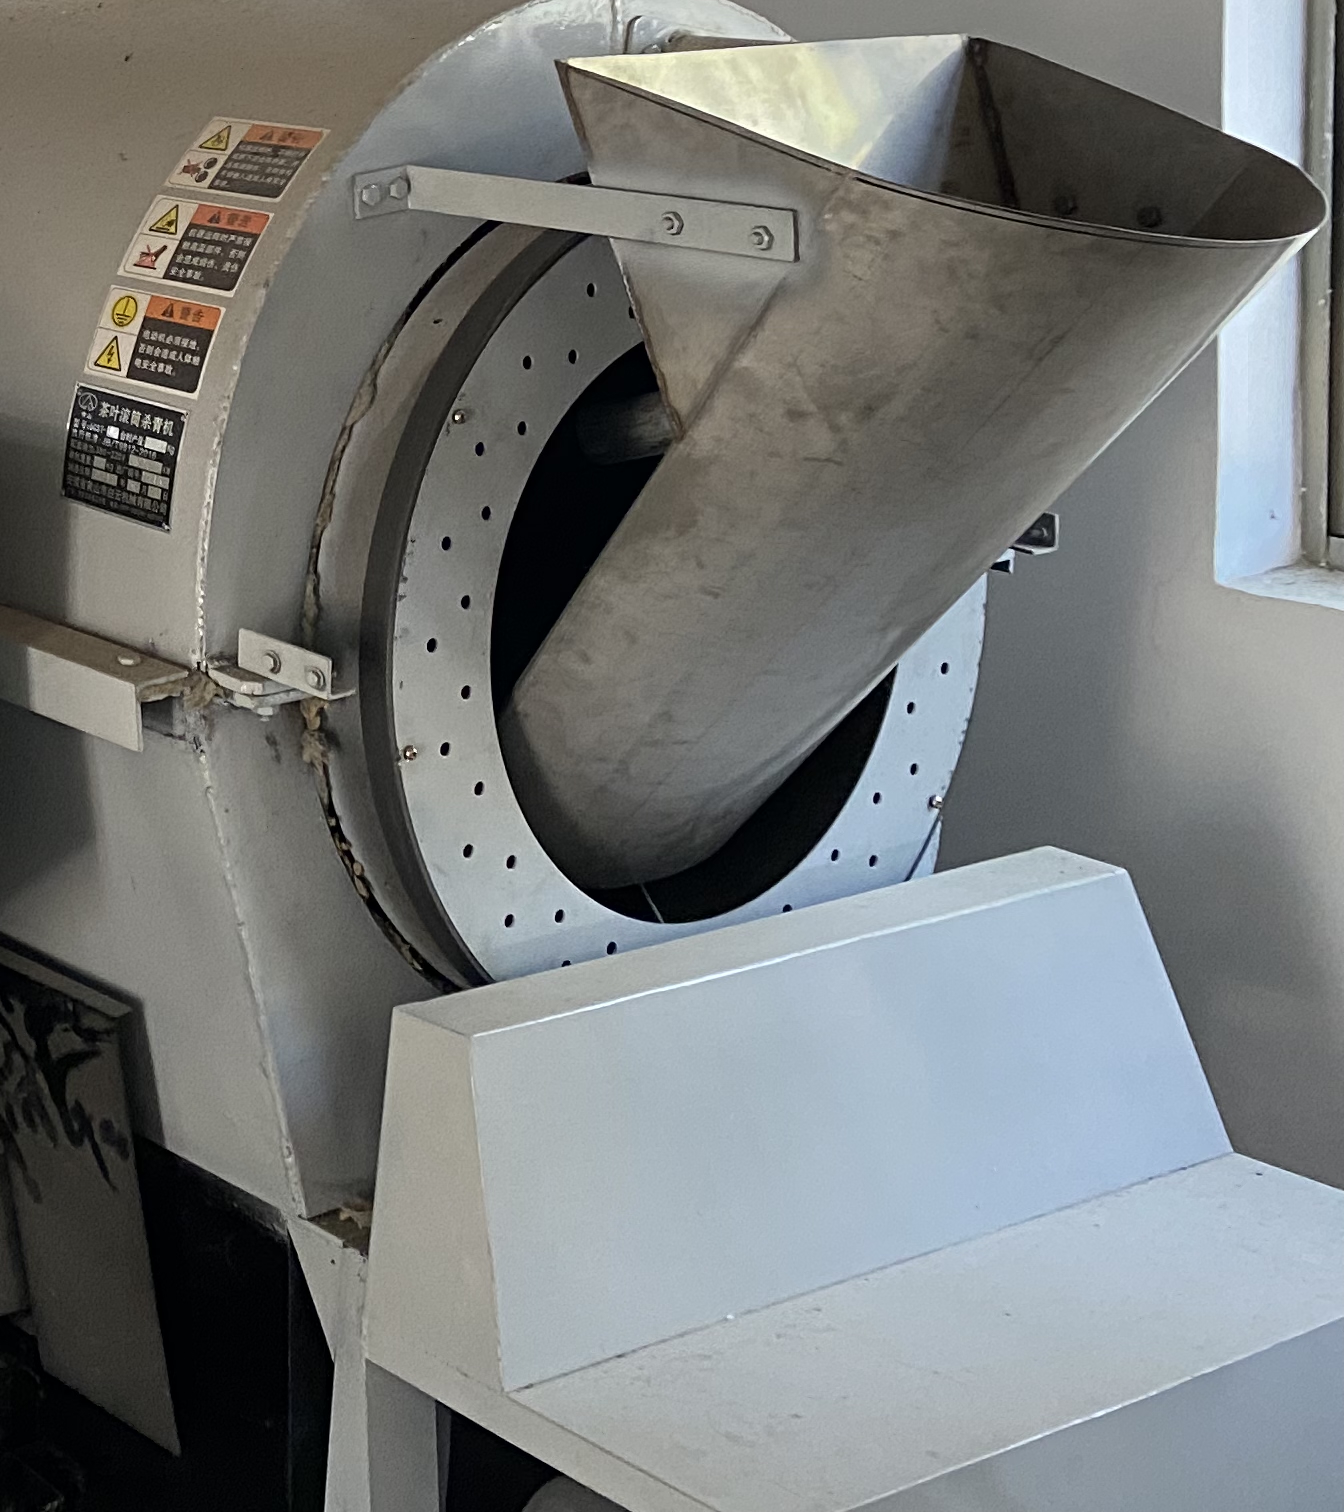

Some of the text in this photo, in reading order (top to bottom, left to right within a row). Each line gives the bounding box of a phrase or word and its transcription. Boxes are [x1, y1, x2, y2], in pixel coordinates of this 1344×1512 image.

[98, 401, 174, 436] 茶叶滚筒杀青机
